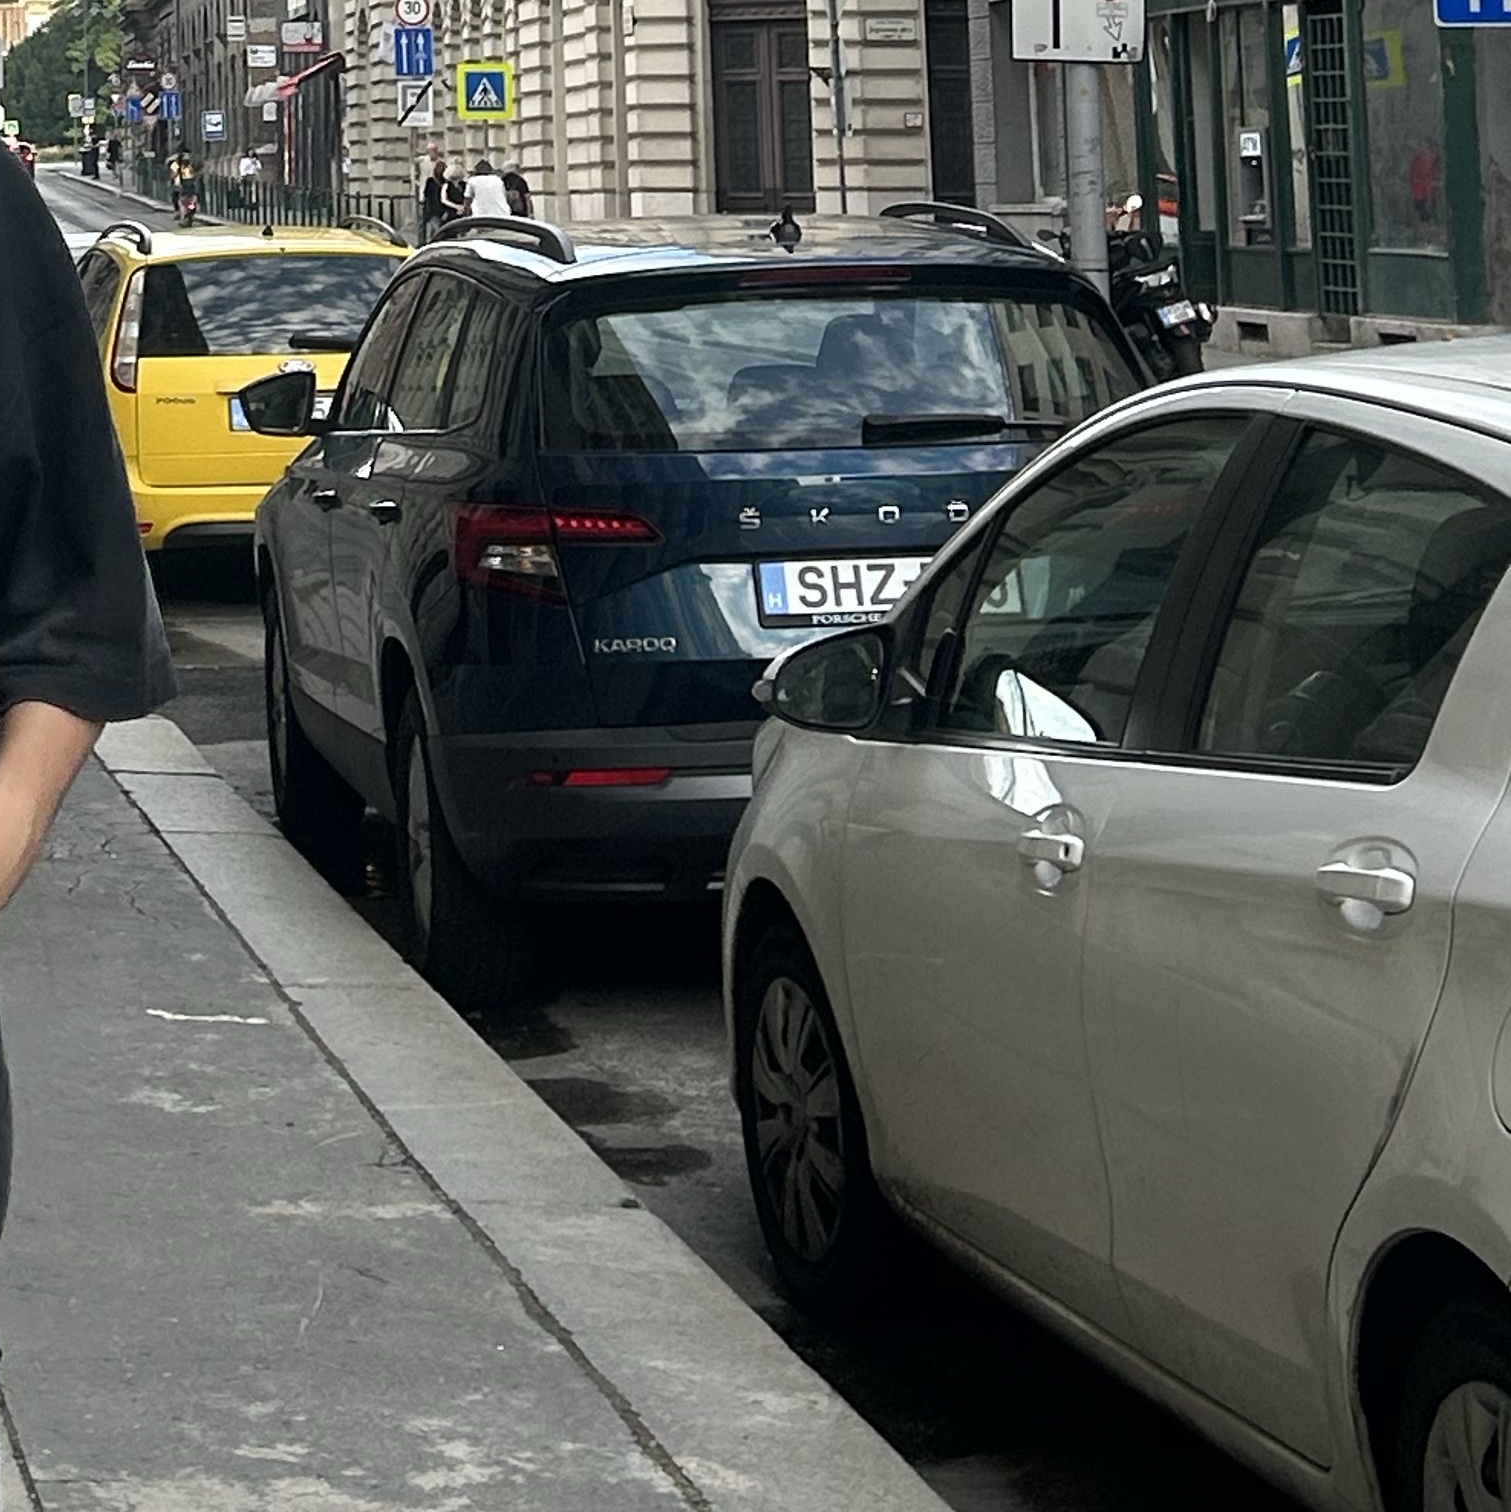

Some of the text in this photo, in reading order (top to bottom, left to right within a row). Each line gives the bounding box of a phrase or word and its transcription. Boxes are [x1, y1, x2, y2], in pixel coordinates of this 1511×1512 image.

[403, 0, 421, 15] 30
[738, 499, 971, 531] ŠKOD
[768, 592, 783, 608] H
[811, 613, 882, 626] PORSCHE
[593, 637, 677, 654] KAROQ
